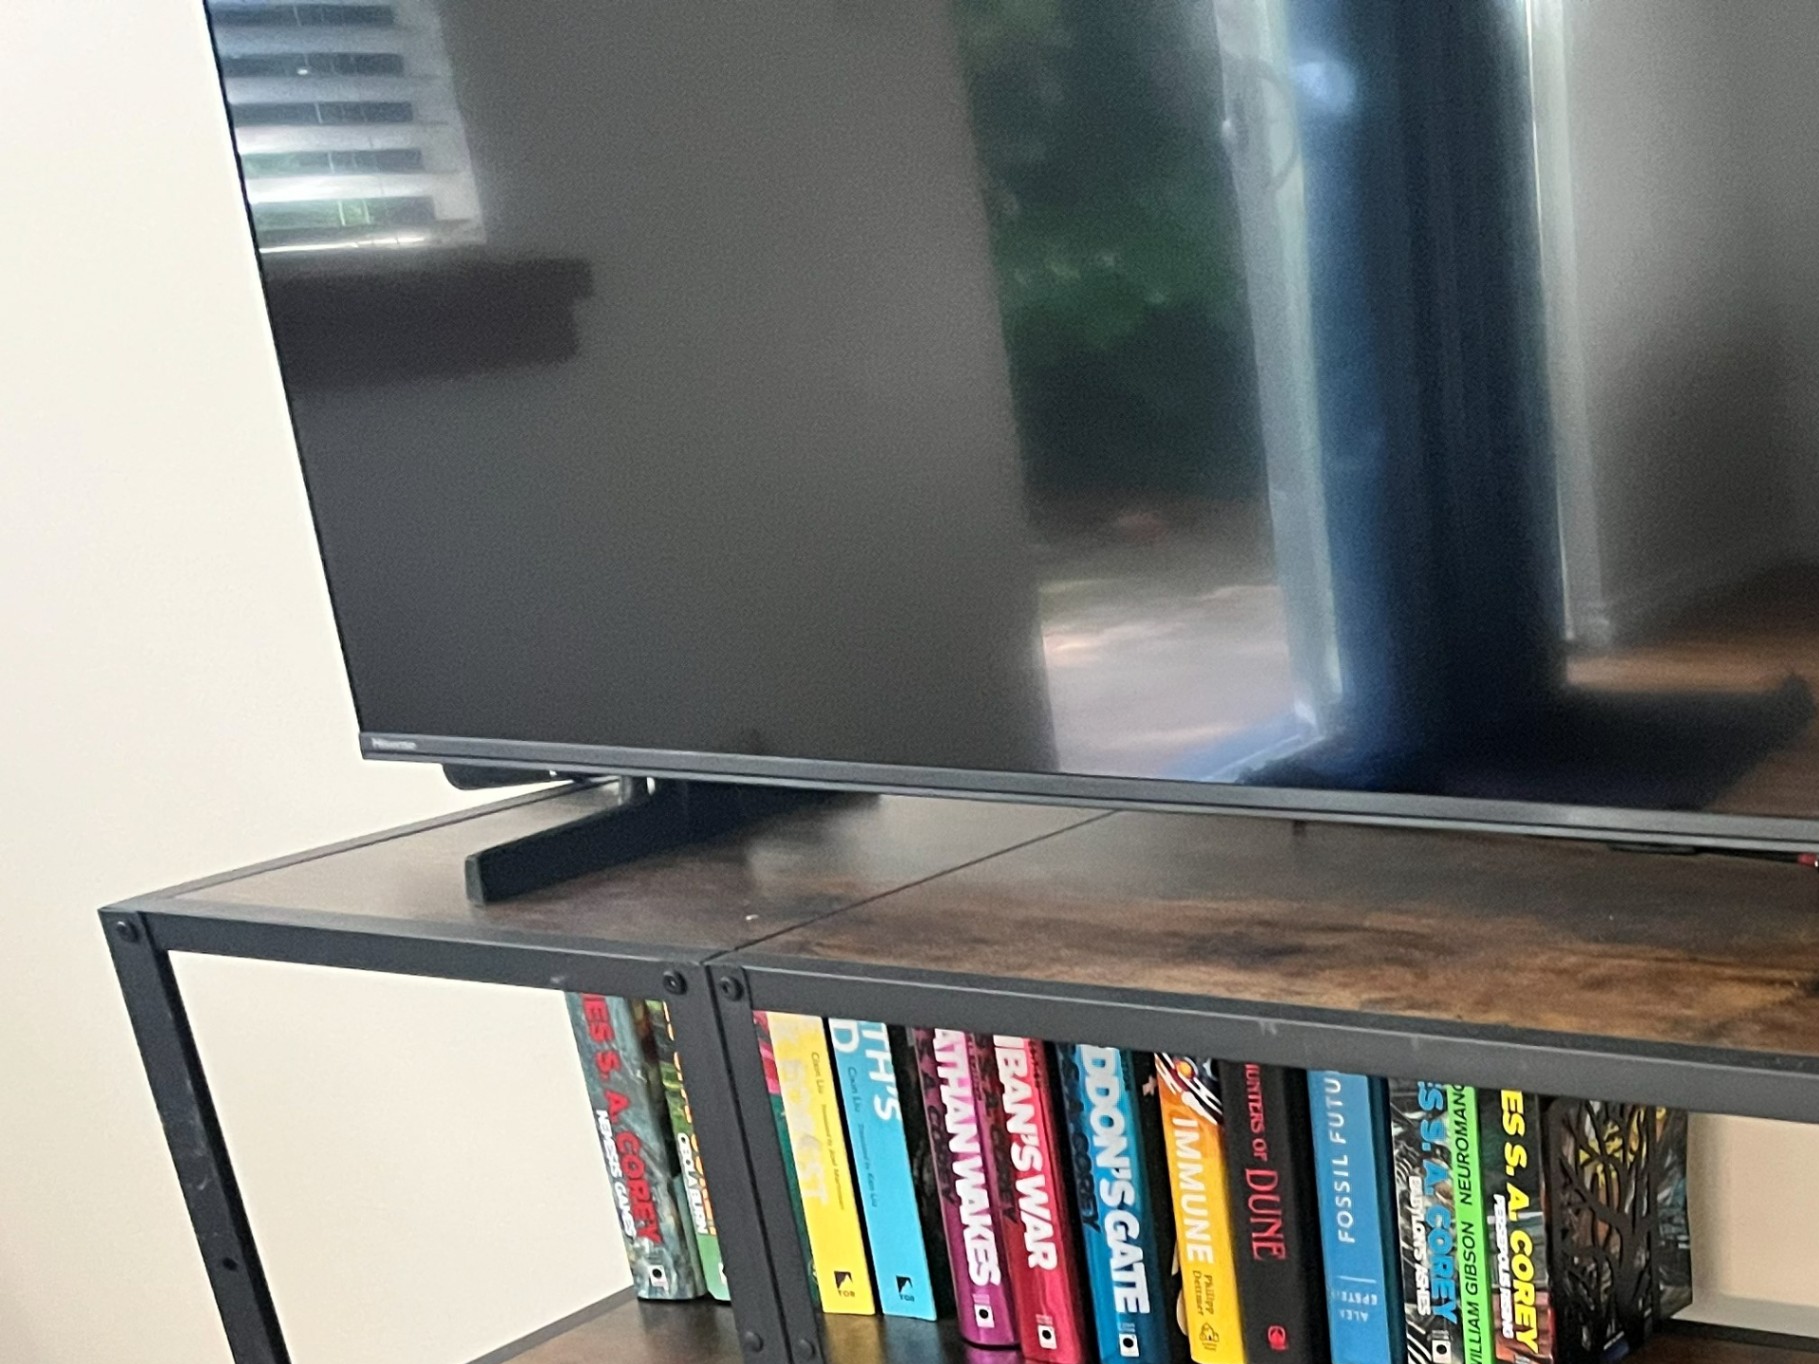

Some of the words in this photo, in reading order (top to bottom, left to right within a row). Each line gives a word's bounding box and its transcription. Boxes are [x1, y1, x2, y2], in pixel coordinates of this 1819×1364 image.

[581, 993, 615, 1042] ES
[615, 1130, 664, 1244] COREY
[933, 1028, 981, 1153] ATHAN
[993, 1034, 1044, 1172] IBAN'S
[1081, 1044, 1135, 1207] DDON'S
[1323, 1076, 1347, 1145] FUTU
[1500, 1089, 1526, 1137] ES
[596, 1109, 623, 1179] NEMESIS
[614, 1181, 637, 1240] GAMES
[1172, 1117, 1216, 1265] IMMUNE
[1452, 1084, 1472, 1206] NEUROMANC
[1504, 1142, 1528, 1176] S.
[690, 1187, 710, 1235] BURN
[952, 1155, 1001, 1287] WAKES
[1015, 1174, 1058, 1271] WAR
[1245, 1167, 1287, 1261] DUNE
[1332, 1153, 1356, 1244] FOSSIL
[1506, 1182, 1530, 1222] A.
[1104, 1209, 1151, 1314] GATE
[1413, 1262, 1432, 1316] ASHES
[1425, 1204, 1458, 1326] COREY
[1461, 1221, 1478, 1296] GIBSON
[1509, 1229, 1539, 1355] COREY
